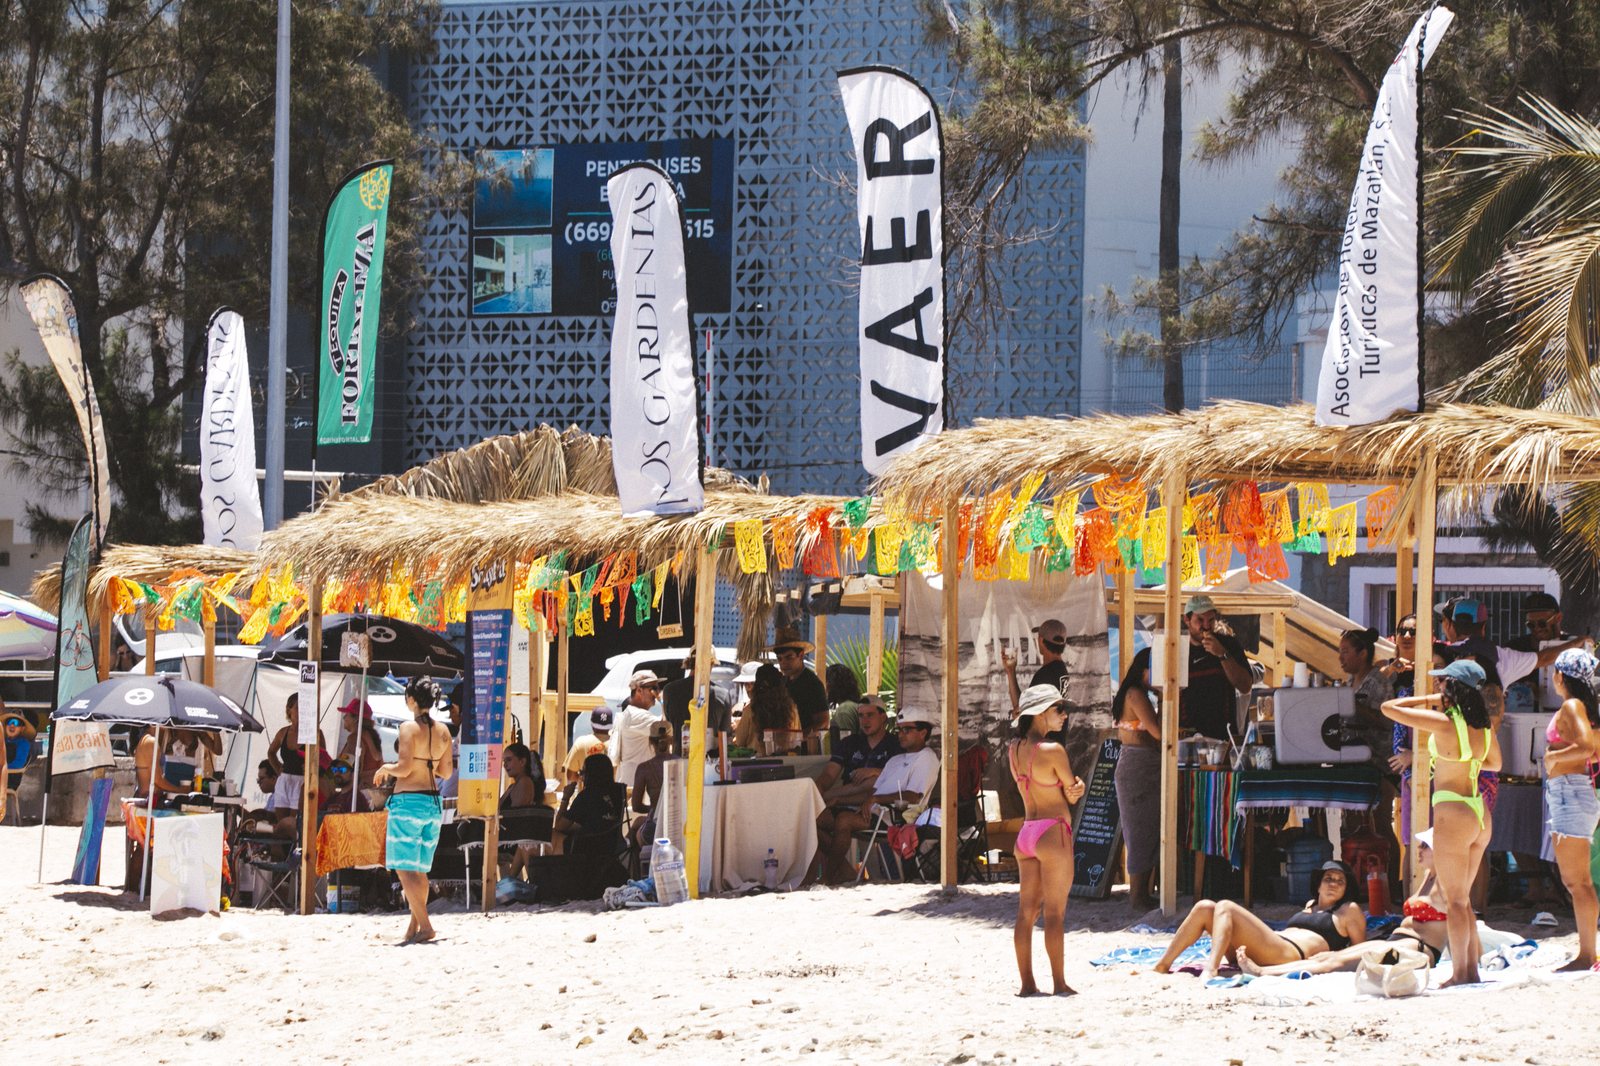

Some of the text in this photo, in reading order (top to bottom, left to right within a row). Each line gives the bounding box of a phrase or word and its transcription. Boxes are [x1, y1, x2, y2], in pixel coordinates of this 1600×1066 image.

[330, 281, 346, 368] TEQUILA
[342, 219, 377, 427] FORTEZA
[631, 181, 672, 427] GARDENIAS
[862, 111, 938, 456] VAER
[1358, 248, 1377, 275] de
